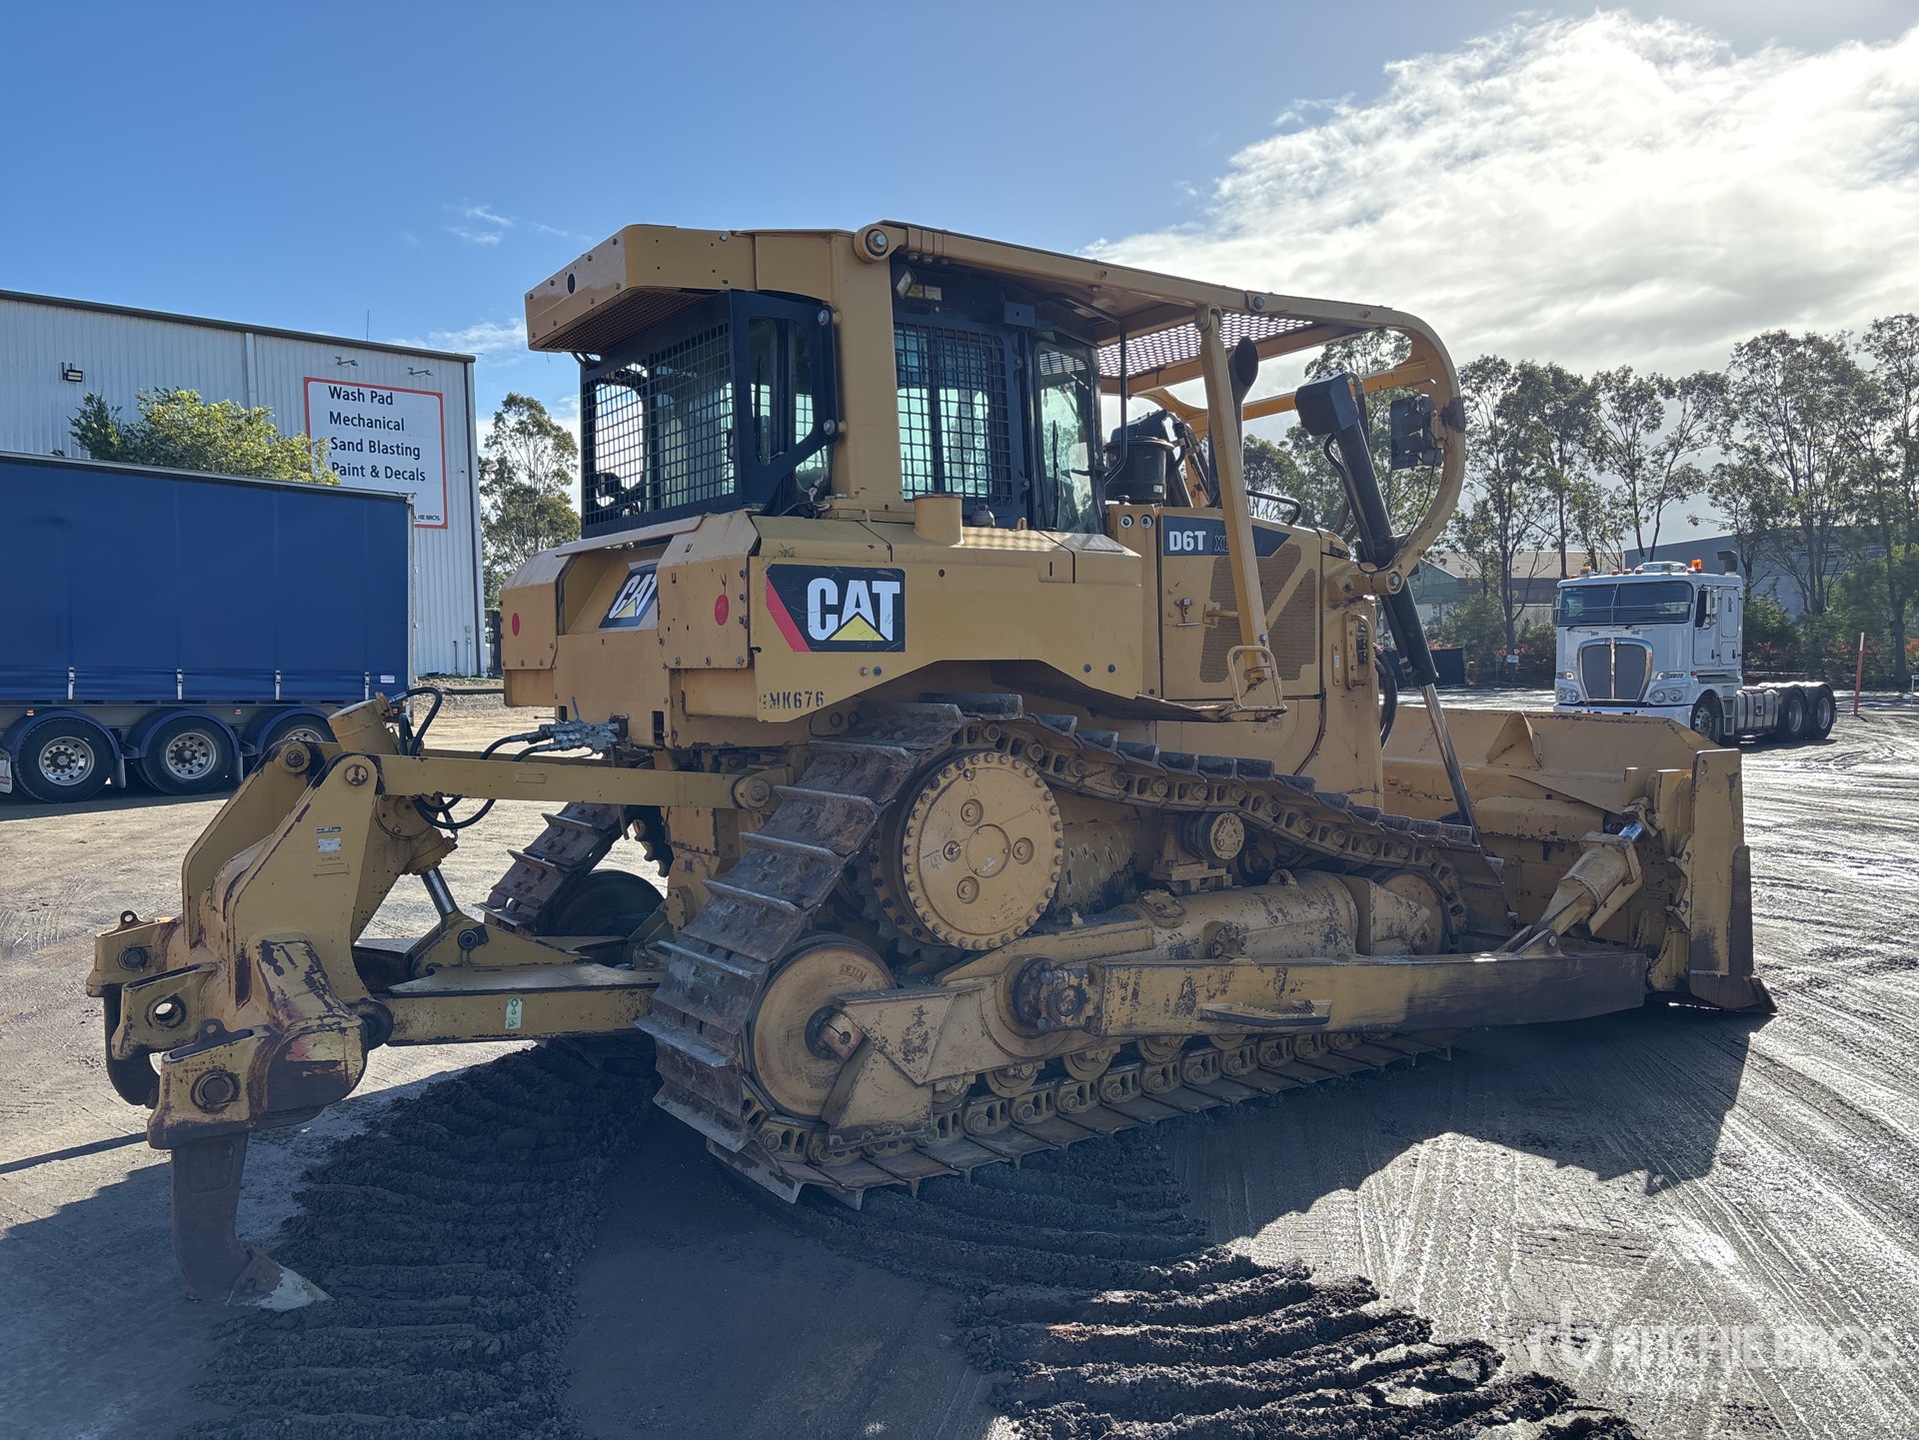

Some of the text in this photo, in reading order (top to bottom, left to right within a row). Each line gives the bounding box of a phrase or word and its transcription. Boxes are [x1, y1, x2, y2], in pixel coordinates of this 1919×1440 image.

[328, 385, 394, 405] Wash Pad
[329, 411, 405, 431] Mechanical
[330, 437, 421, 460] Sand Blasting
[331, 461, 426, 481] Paint & Decals
[1169, 530, 1206, 551] D6T
[608, 573, 658, 619] CAT
[807, 577, 901, 642] CAT
